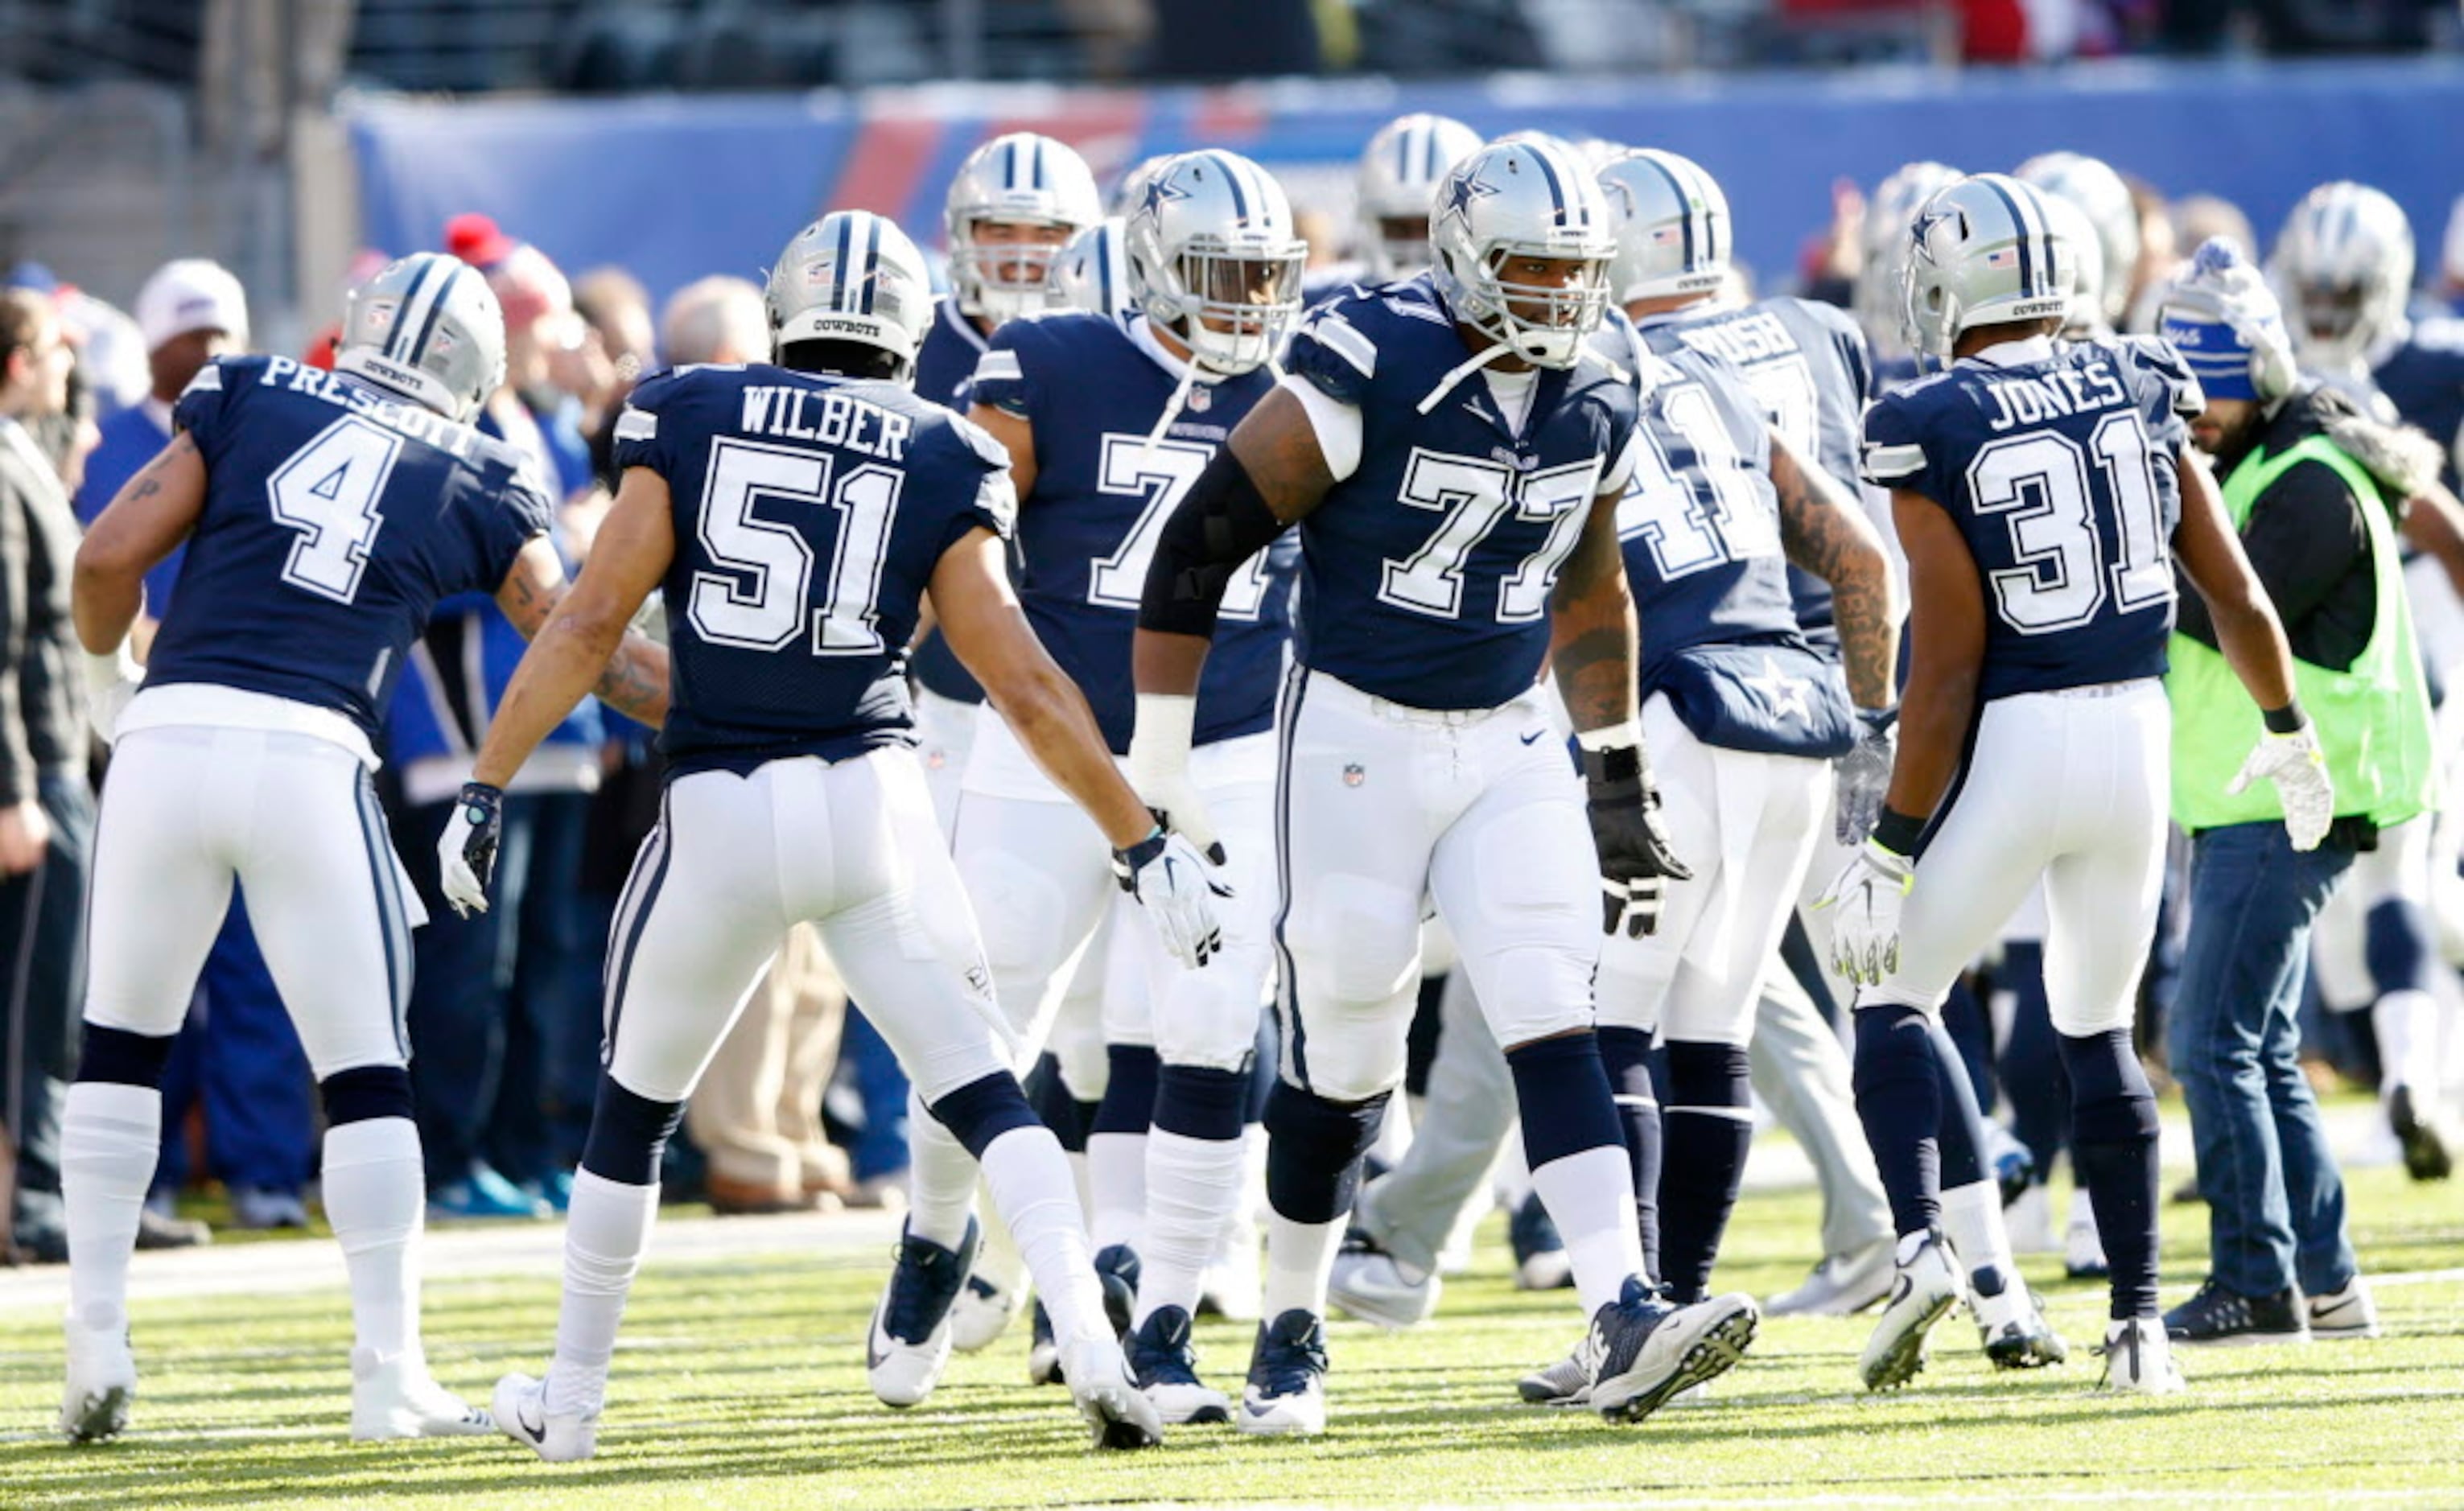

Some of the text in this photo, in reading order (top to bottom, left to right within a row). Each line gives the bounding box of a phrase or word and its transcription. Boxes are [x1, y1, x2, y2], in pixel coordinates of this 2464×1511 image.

[260, 355, 478, 456] PRESCOTT
[813, 319, 880, 337] COWBOYS
[1987, 362, 2125, 430] JONES
[266, 413, 405, 606] 4
[742, 385, 913, 462] WILBER
[1615, 382, 1788, 582] 41
[686, 434, 906, 656] 51
[1087, 431, 1275, 621] 7
[1376, 445, 1607, 624] 77
[1965, 407, 2179, 636] 31
